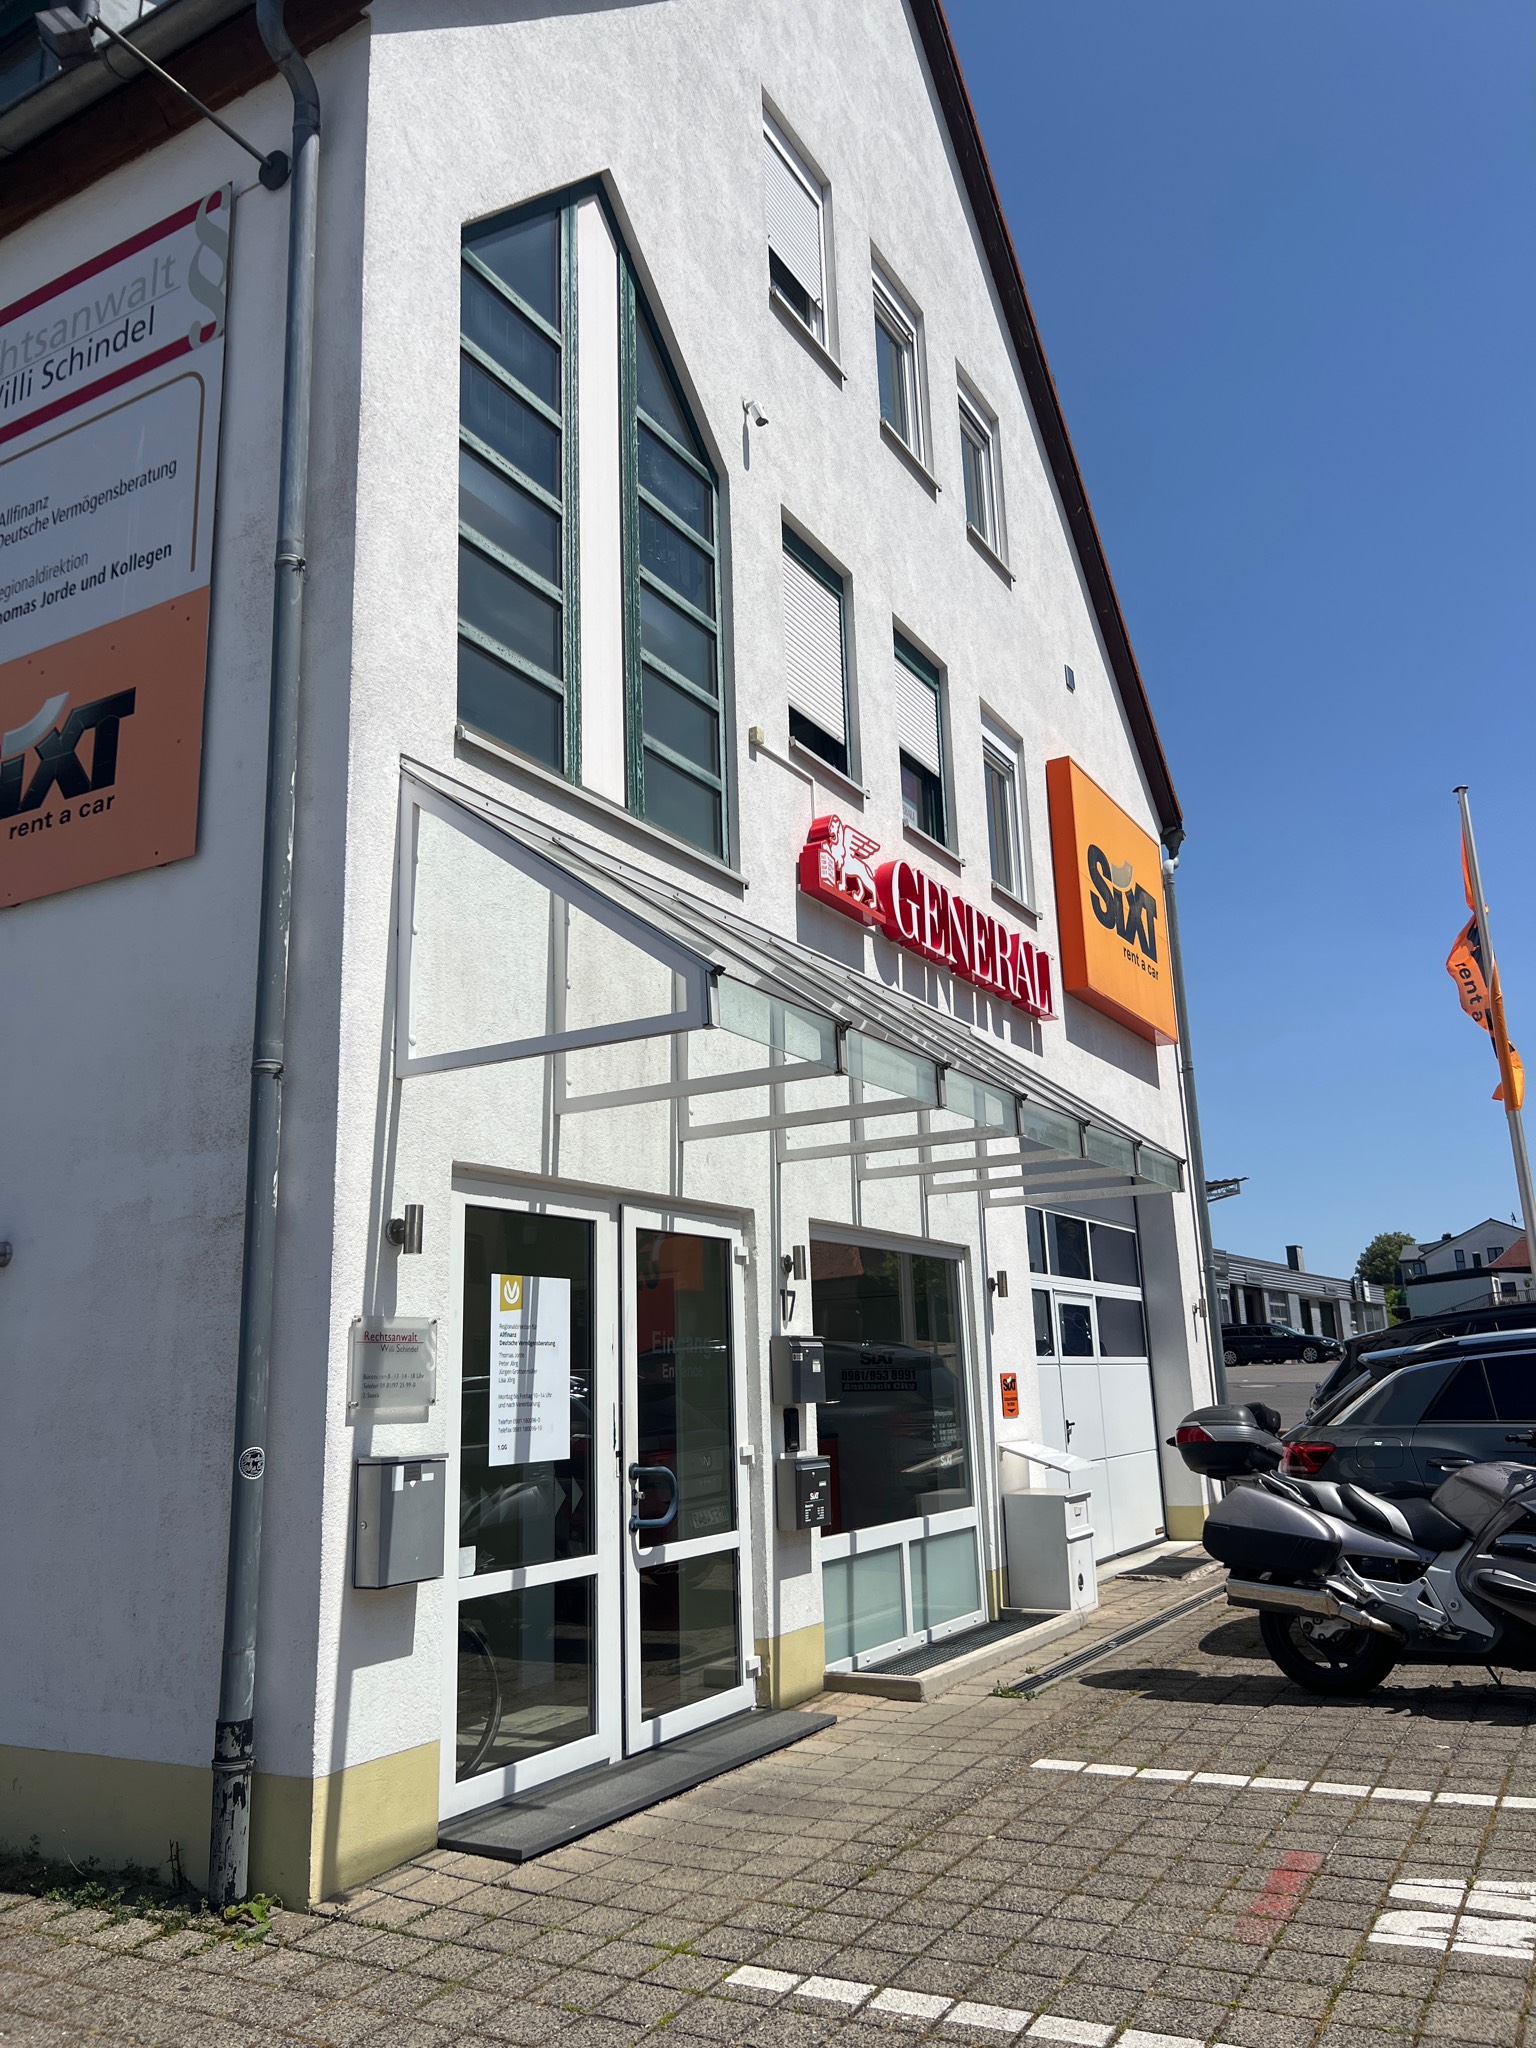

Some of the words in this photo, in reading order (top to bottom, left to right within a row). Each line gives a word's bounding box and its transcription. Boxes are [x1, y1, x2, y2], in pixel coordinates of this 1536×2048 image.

[0, 254, 177, 375] htsanwalt
[0, 368, 33, 409] illi
[41, 305, 155, 390] Schindel
[51, 459, 178, 526] Vermögensberatung
[0, 496, 49, 527] Allfinanz
[0, 552, 89, 603] egionaldirektion
[40, 580, 77, 609] Jorde
[81, 566, 106, 592] und
[110, 543, 172, 580] Kollegen
[8, 812, 53, 840] rent
[59, 809, 72, 825] a
[79, 794, 116, 819] car
[1123, 946, 1140, 967] rent
[1141, 959, 1147, 971] a
[1147, 965, 1159, 981] car
[1455, 962, 1483, 1005] rent
[780, 1289, 796, 1322] 17
[364, 1330, 418, 1342] Rechtsanwalt
[396, 1343, 419, 1353] Schindel
[652, 1330, 712, 1360] Eingang
[841, 1369, 889, 1382] 0981/953
[891, 1368, 916, 1381] 8991
[843, 1381, 892, 1391] Ansbach
[892, 1381, 916, 1391] City
